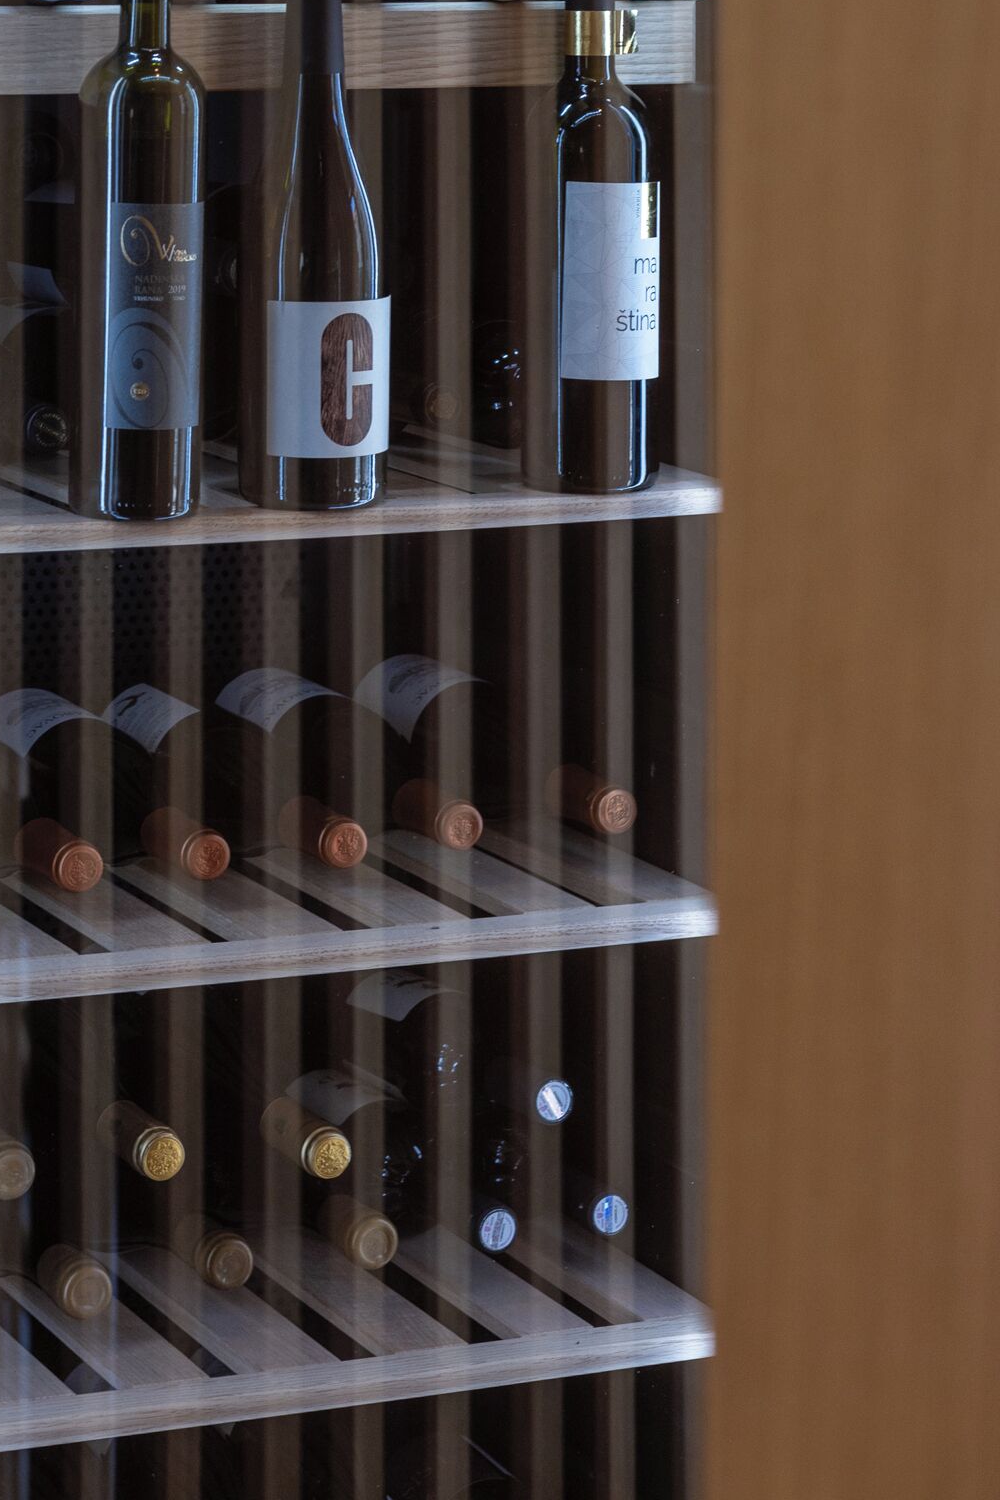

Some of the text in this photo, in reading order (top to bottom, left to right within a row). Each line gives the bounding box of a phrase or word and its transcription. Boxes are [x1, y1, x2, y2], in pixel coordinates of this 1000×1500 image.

[634, 256, 657, 274] ma
[168, 284, 186, 294] 2019
[645, 284, 657, 302] ra
[615, 309, 656, 332] ština
[320, 312, 374, 446] C
